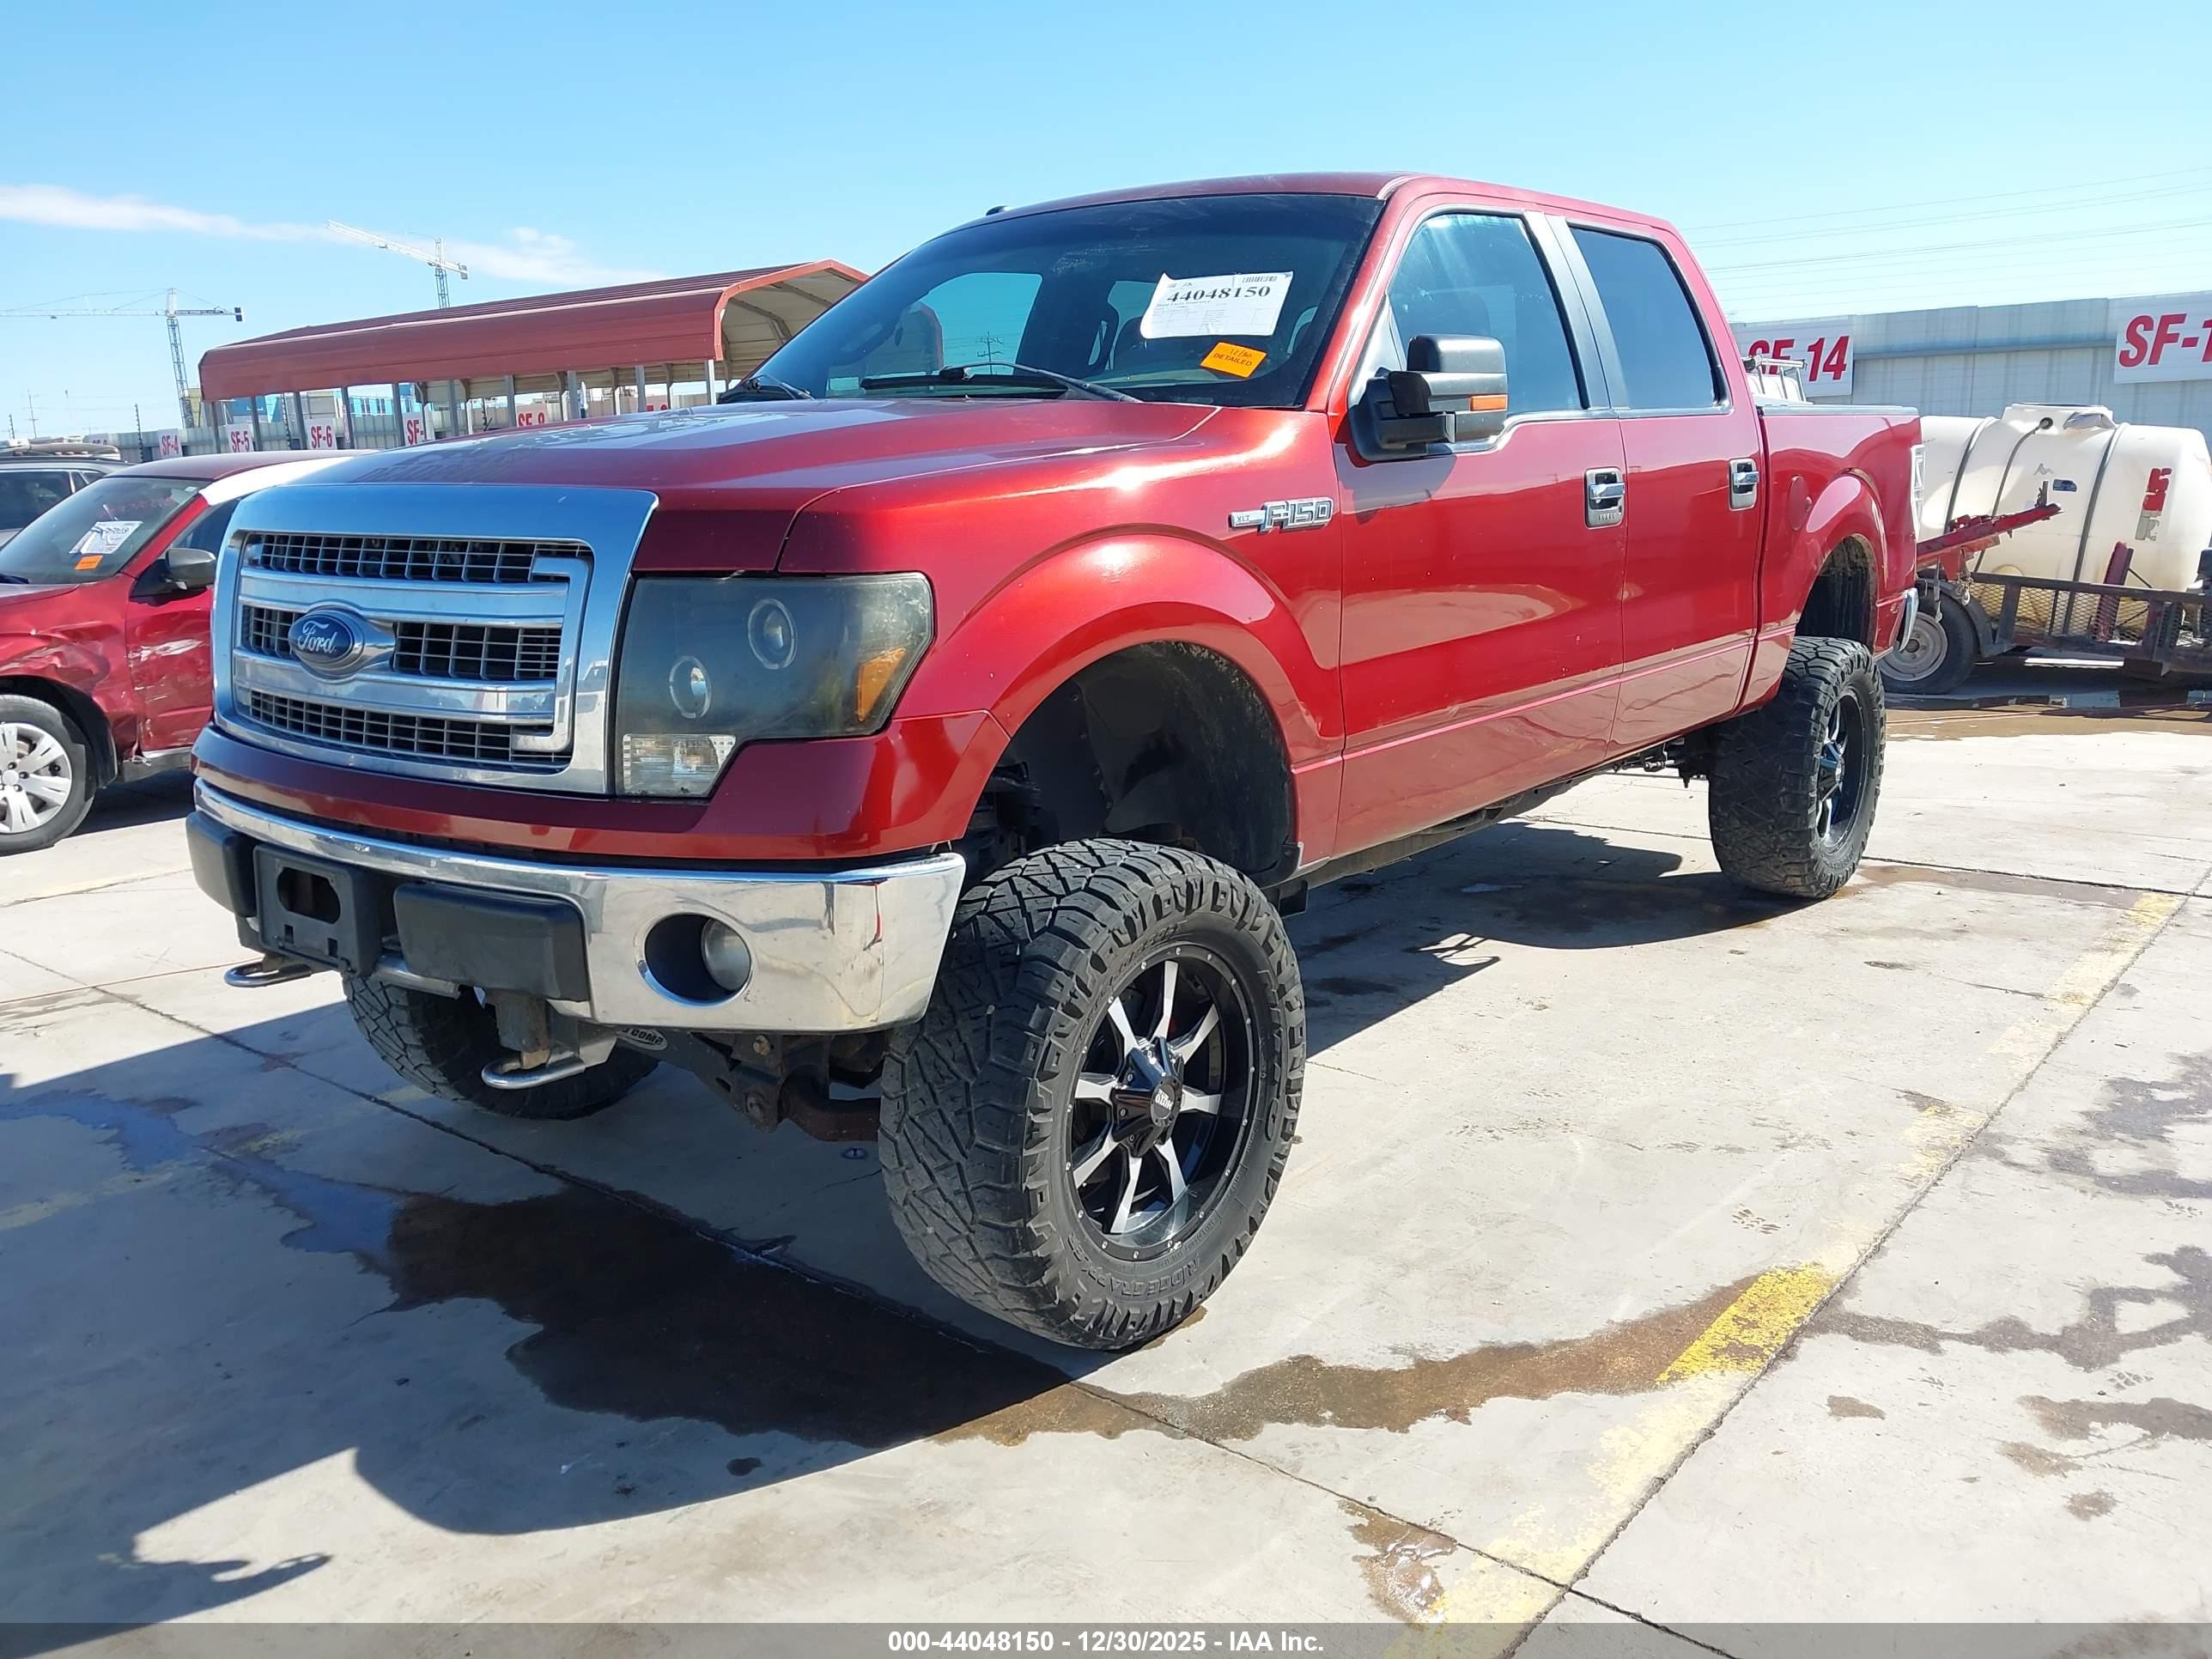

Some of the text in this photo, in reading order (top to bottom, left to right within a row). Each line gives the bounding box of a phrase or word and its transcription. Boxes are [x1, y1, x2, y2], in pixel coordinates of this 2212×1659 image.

[1167, 285, 1271, 302] 44048150
[1212, 352, 1253, 367] DETAILED
[1747, 335, 1850, 382] SF14
[229, 430, 250, 453] SF-5
[310, 425, 333, 449] SF-6
[406, 419, 424, 446] SF-
[161, 434, 179, 456] SF-4
[1237, 500, 1333, 531] XLT F-150
[297, 620, 337, 653] Ford
